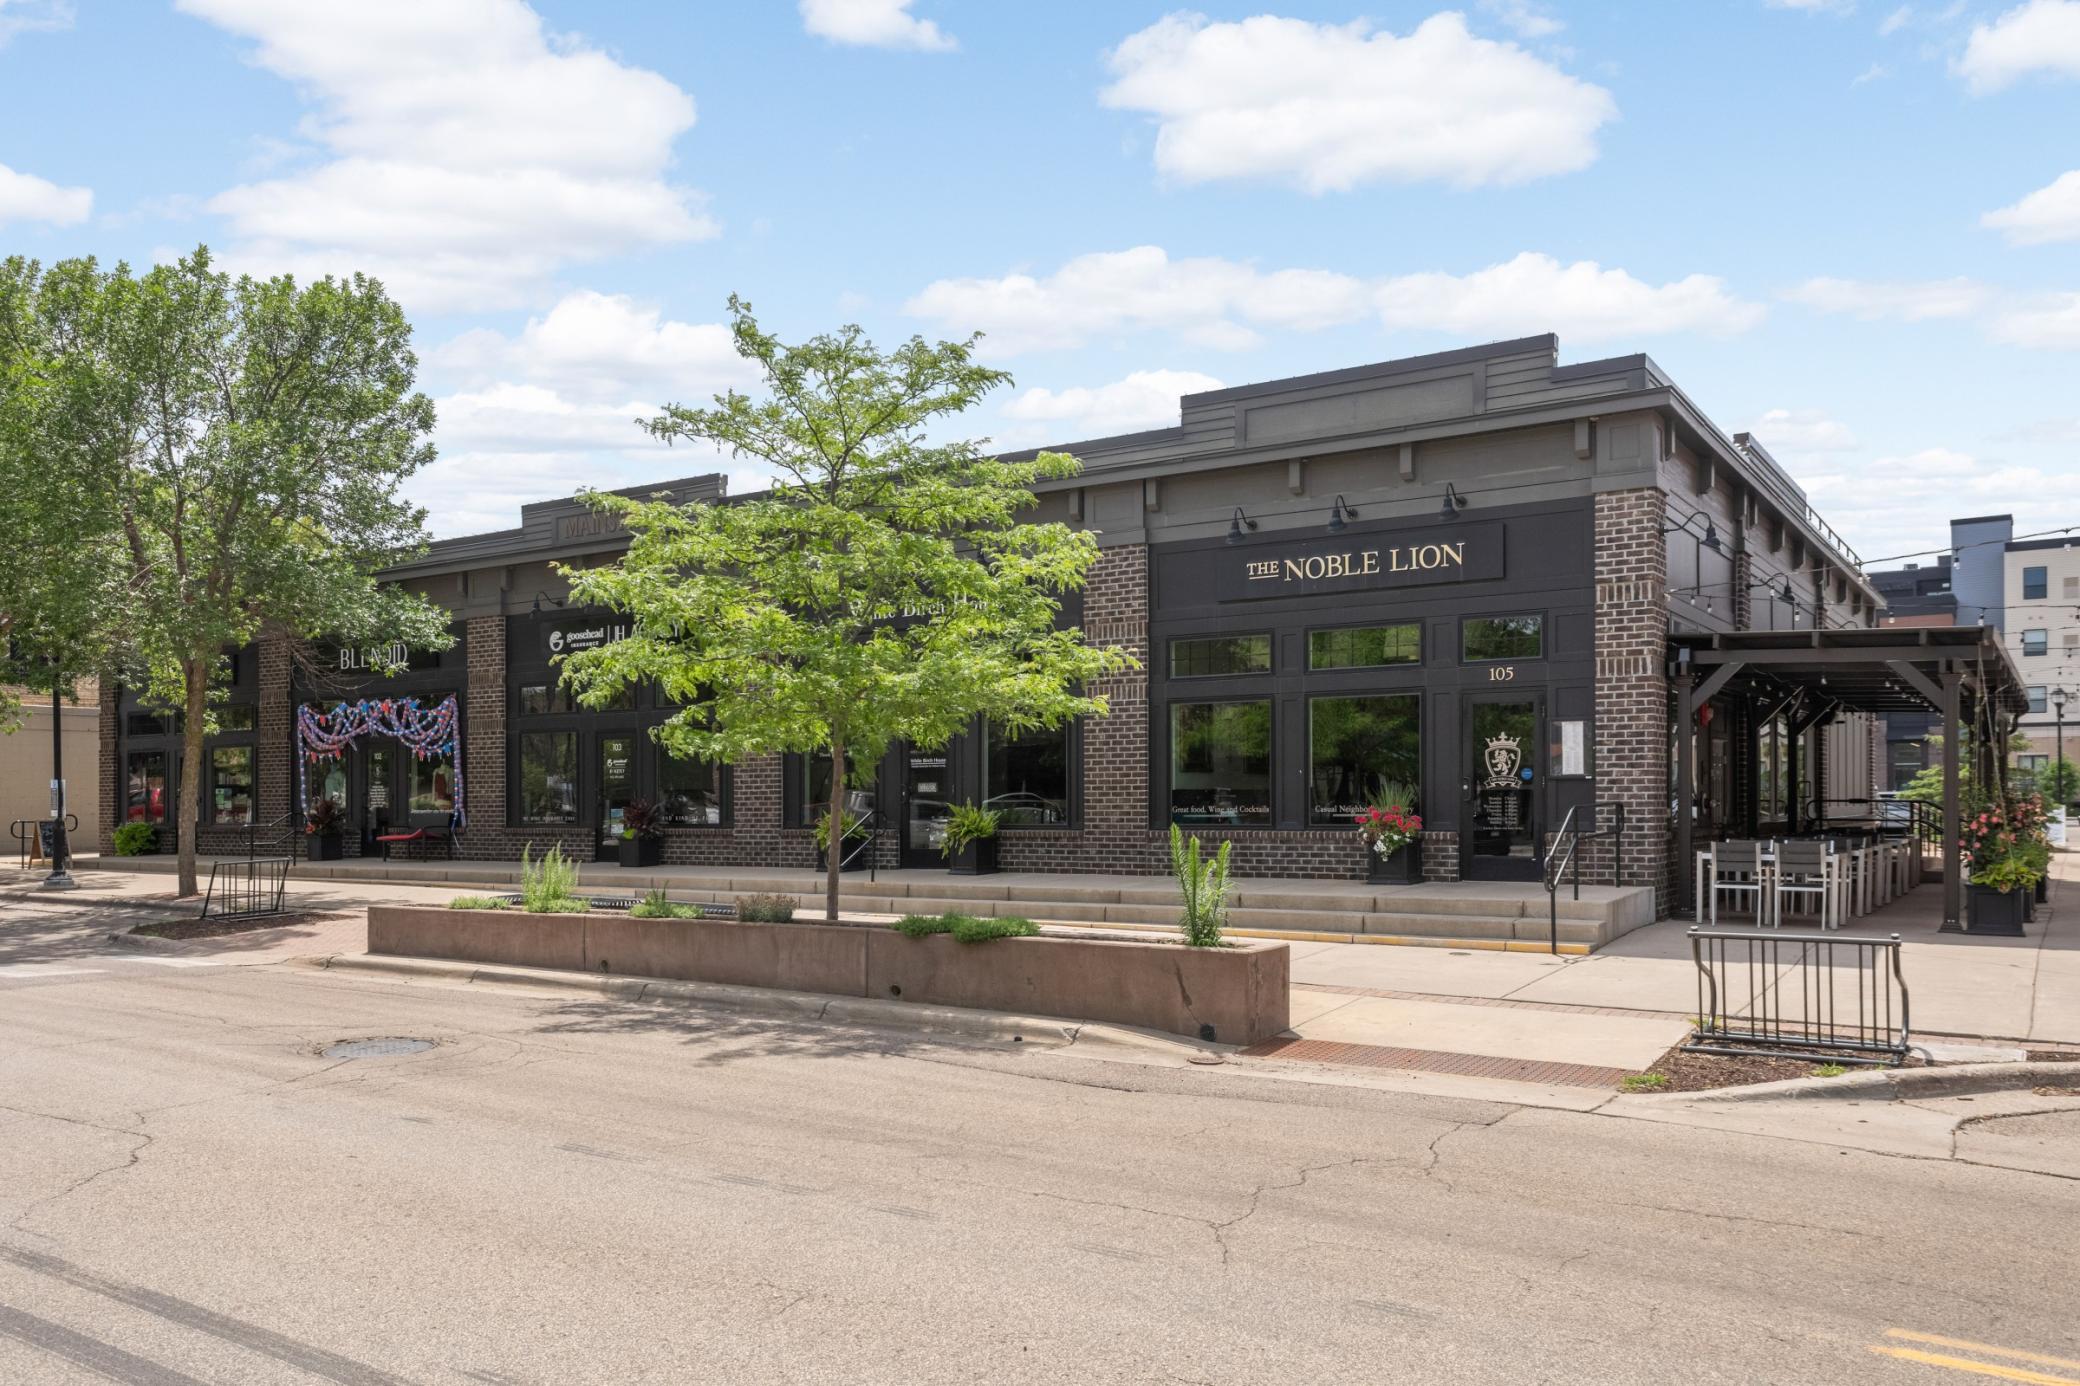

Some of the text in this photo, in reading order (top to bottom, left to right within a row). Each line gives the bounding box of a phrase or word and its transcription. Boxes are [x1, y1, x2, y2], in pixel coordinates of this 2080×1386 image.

[1246, 543, 1465, 581] THE NOBLE LION
[566, 628, 604, 643] goosehead
[1489, 667, 1514, 681] 105
[612, 743, 622, 752] 103
[1172, 805, 1189, 813] Great
[1239, 804, 1270, 813] Cocktails
[1315, 804, 1337, 813] Casual
